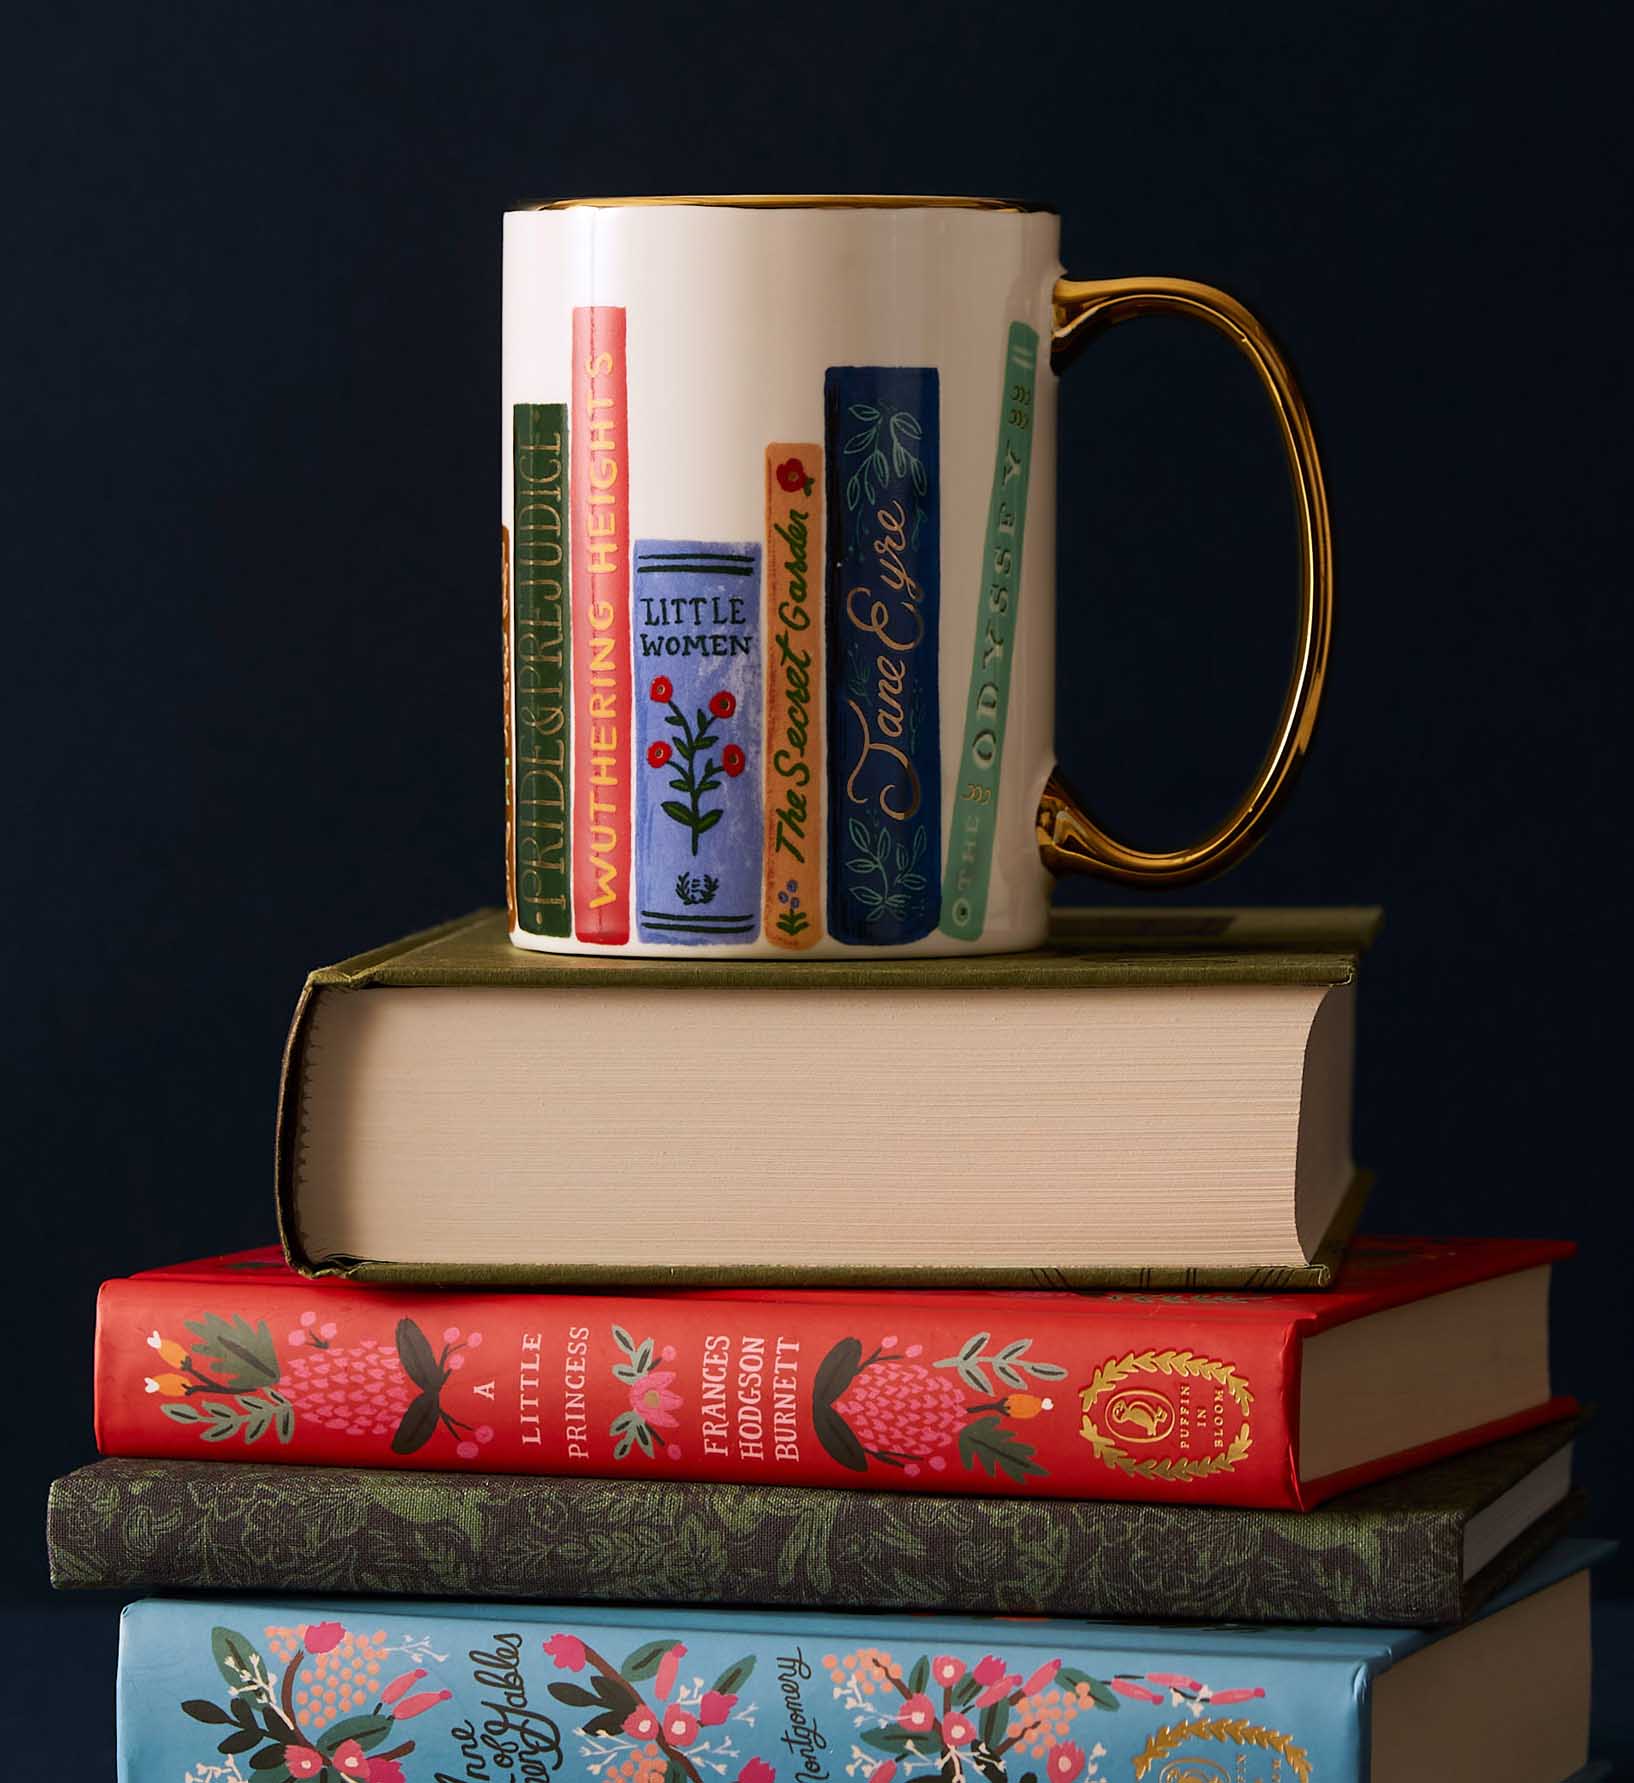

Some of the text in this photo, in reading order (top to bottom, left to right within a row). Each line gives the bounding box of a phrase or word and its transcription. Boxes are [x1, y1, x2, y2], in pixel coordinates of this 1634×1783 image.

[585, 351, 618, 909] WUTHERING HEIGHTS
[639, 597, 747, 626] LITTLE
[639, 633, 753, 657] WOMEN
[846, 500, 925, 821] Jane Eyre
[972, 440, 1021, 769] ODYSSEY
[773, 508, 812, 864] The Secret Garden
[472, 1379, 497, 1401] A
[519, 1332, 543, 1447] LITTLE
[564, 1326, 591, 1460] PRINCESS
[701, 1334, 732, 1457] FRANCES
[737, 1335, 766, 1462] HODGSON
[773, 1335, 801, 1463] BURNETT
[1179, 1385, 1191, 1449] PUFFIN
[1197, 1408, 1208, 1428] IN
[434, 1719, 490, 1783] nne
[468, 1632, 564, 1771] Gables
[479, 1733, 520, 1769] of
